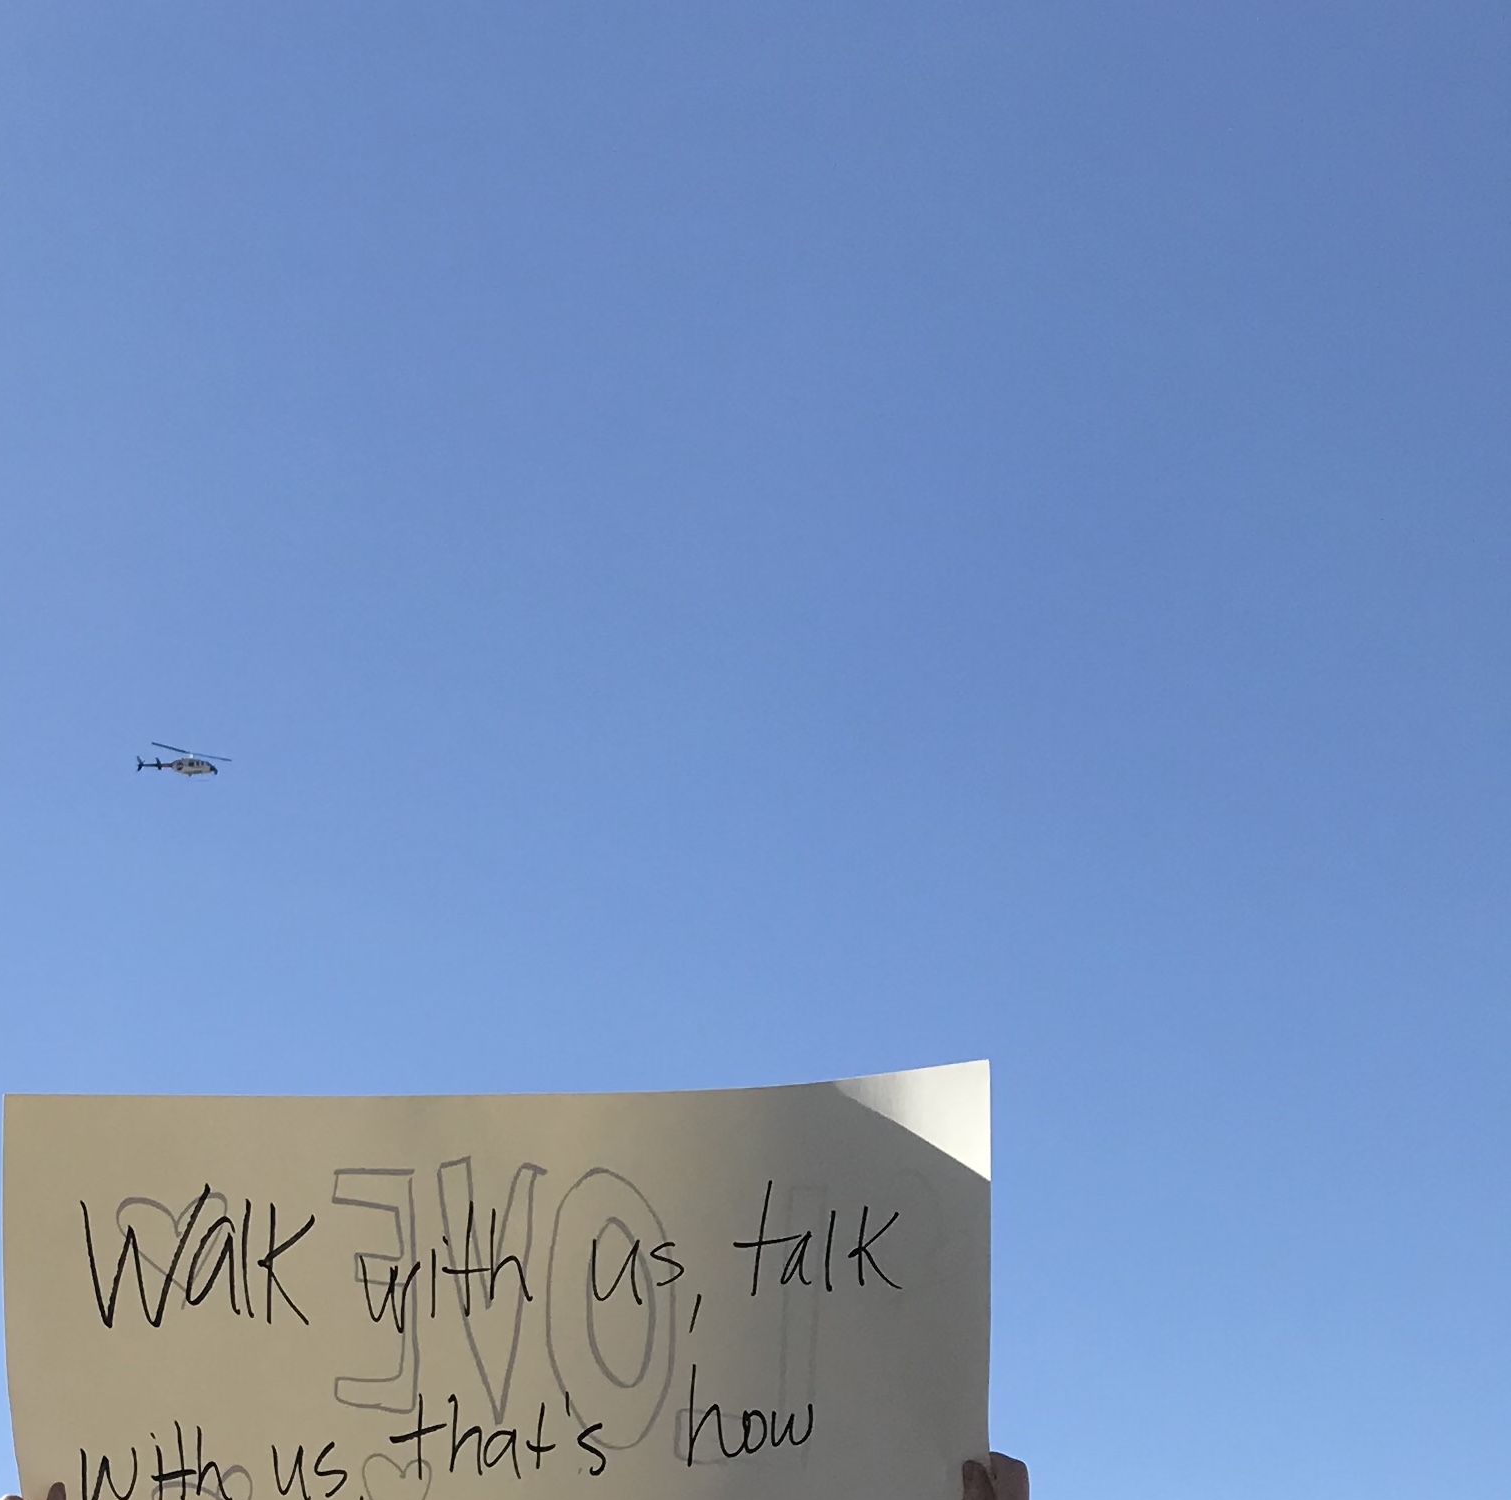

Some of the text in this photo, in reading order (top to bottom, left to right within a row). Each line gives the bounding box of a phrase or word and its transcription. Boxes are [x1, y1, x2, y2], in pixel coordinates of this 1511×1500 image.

[78, 1178, 904, 1335] Walk with us, talk
[388, 1390, 608, 1481] that's
[686, 1362, 815, 1469] how
